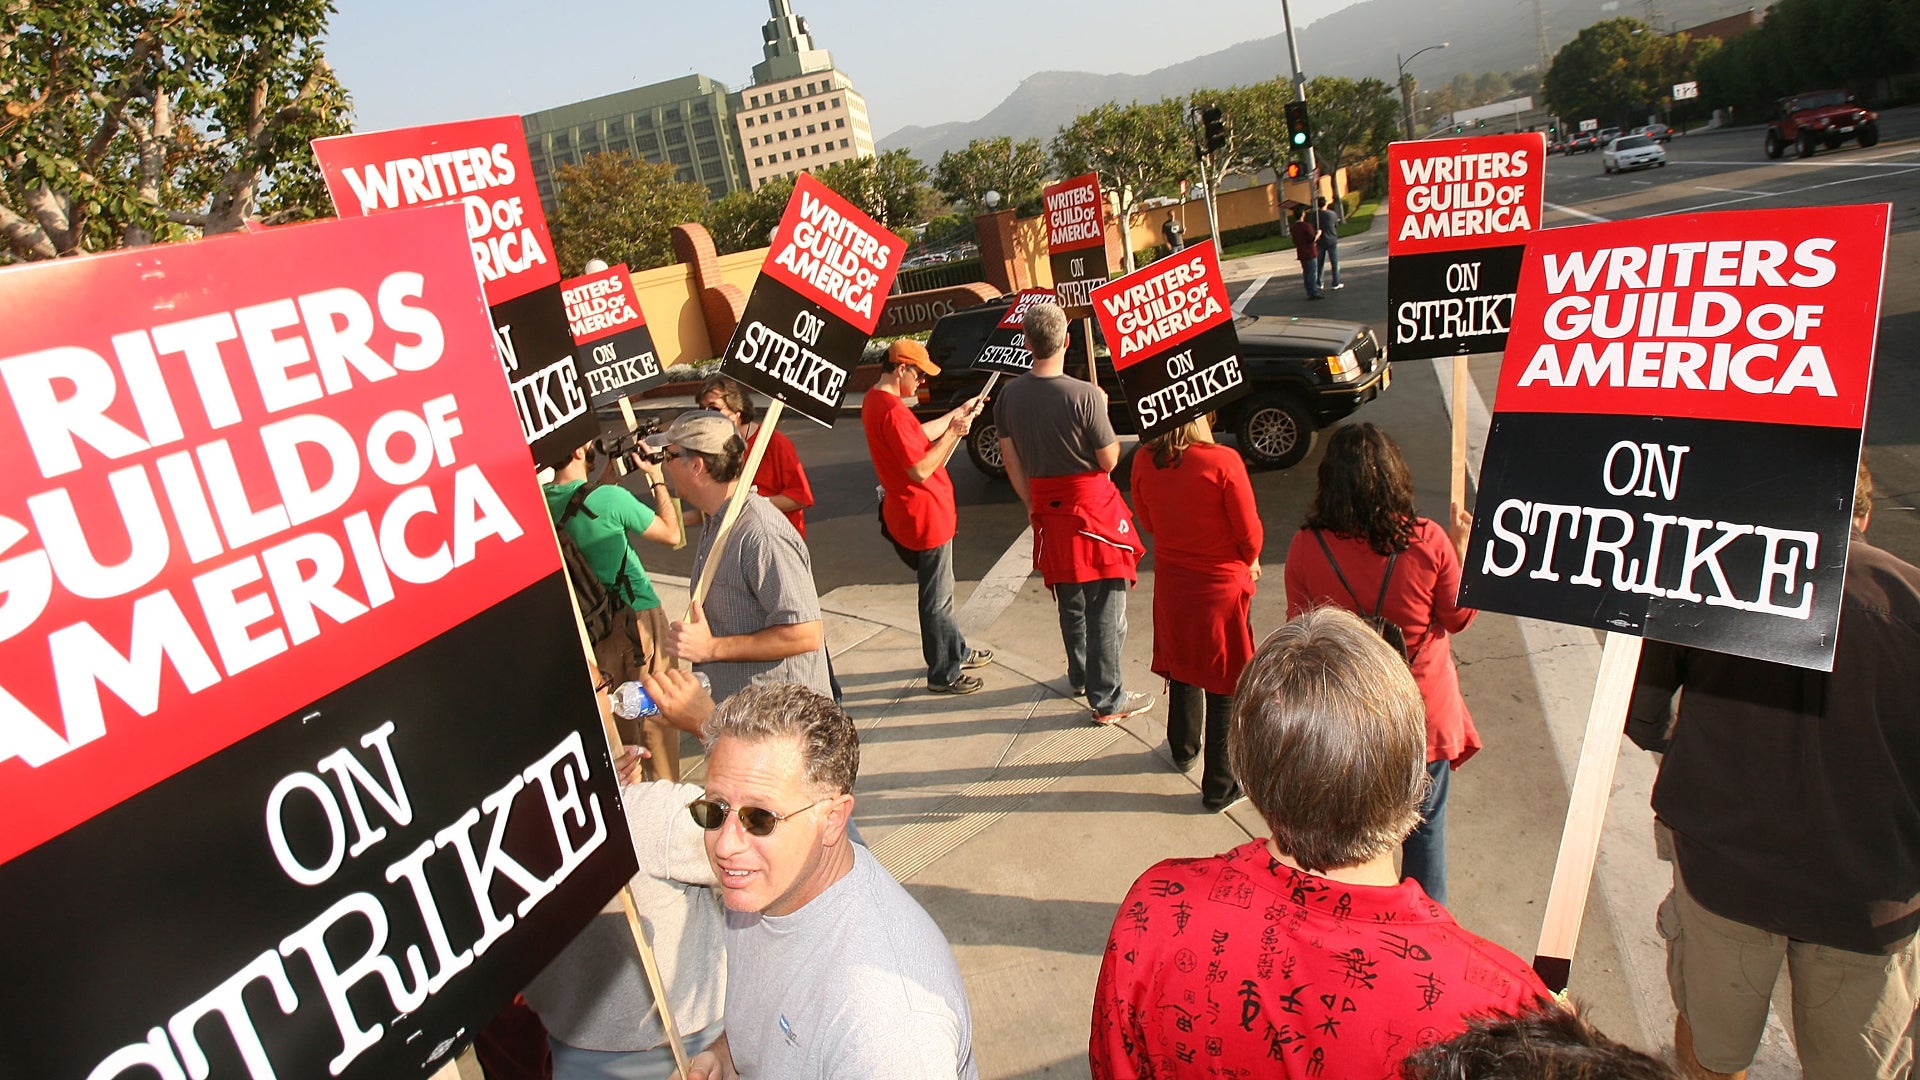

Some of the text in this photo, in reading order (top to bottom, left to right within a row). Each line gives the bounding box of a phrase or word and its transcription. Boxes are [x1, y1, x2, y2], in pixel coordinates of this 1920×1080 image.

[341, 143, 516, 209] WRITERS
[1400, 149, 1528, 187] WRITERS
[491, 196, 524, 232] OF
[1047, 184, 1095, 212] WRITERS
[1051, 205, 1096, 229] GUILD OF
[1406, 181, 1525, 213] GUILD OF
[800, 190, 891, 271] WRITERS
[1051, 220, 1101, 246] AMERICA
[1398, 204, 1532, 242] AMERICA
[471, 226, 547, 284] RICA
[792, 224, 880, 291] GUILD OF
[1070, 257, 1085, 278] ON
[1445, 262, 1481, 292] ON
[1542, 237, 1838, 294] WRITERS
[561, 275, 623, 307] RITERS
[775, 244, 874, 320] AMERICA
[1020, 293, 1057, 305] WRIT
[1057, 277, 1107, 309] STRI
[1102, 256, 1207, 318] WRITERS
[564, 294, 626, 323] UILD OF
[568, 304, 639, 338] MERICA
[791, 309, 827, 348] ON
[887, 299, 955, 326] STUDIOS
[1115, 281, 1210, 335] GUILD OF
[1119, 296, 1223, 359] AMERICA
[1543, 291, 1825, 342] GUILD OF
[0, 270, 444, 479] RITERS
[493, 324, 520, 376] N
[584, 351, 660, 398] TRIKE
[592, 342, 618, 365] ON
[734, 321, 848, 409] STRIKE
[978, 345, 1034, 370] STRIK
[1166, 349, 1196, 381] ON
[1516, 342, 1839, 398] AMERICA
[511, 355, 588, 446] IKE
[1137, 354, 1245, 431] STRIKE
[366, 392, 464, 486] OF
[1602, 439, 1691, 501] ON
[1481, 498, 1820, 621] STRIKE
[266, 721, 412, 886] ON
[85, 730, 608, 1080] TRIKE
